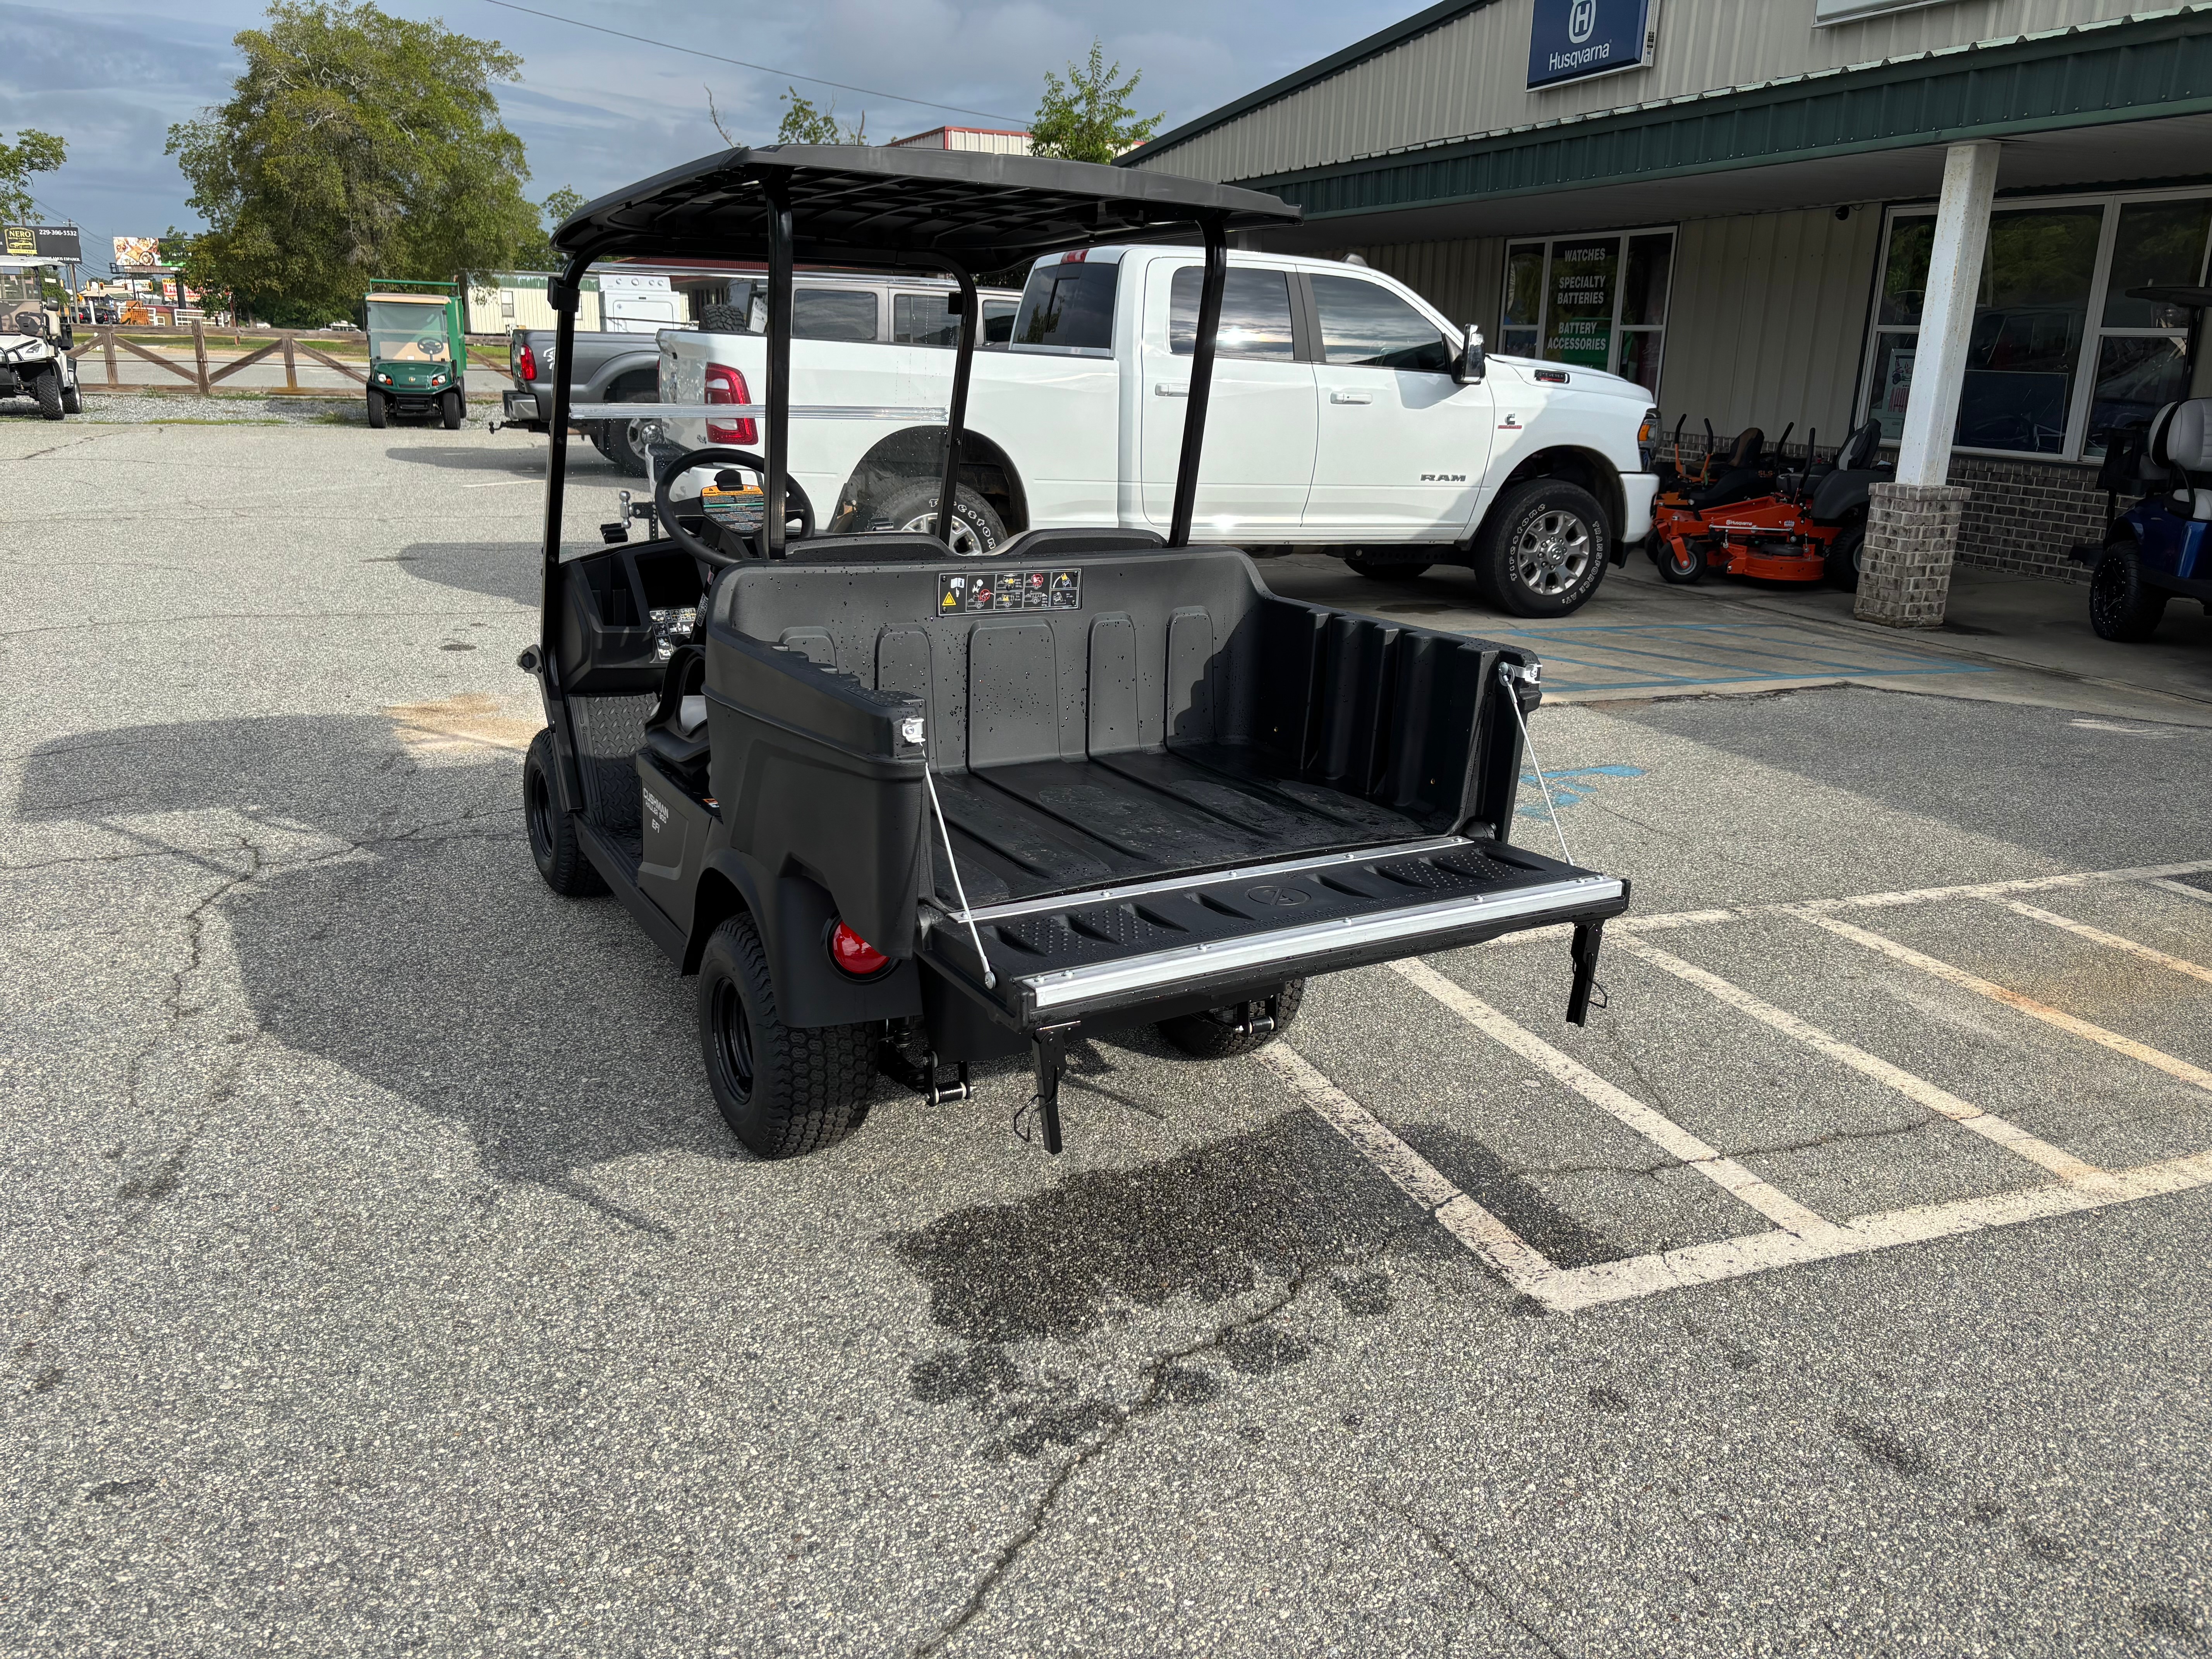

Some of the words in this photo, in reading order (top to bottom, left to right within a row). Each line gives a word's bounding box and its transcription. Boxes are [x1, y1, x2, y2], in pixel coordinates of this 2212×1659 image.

[1549, 43, 1609, 71] Husqvarna
[1565, 248, 1605, 262] WATCHES
[1559, 275, 1606, 289] SPECIALTY
[1558, 292, 1604, 304] BATTERIES
[1558, 322, 1597, 334] BATTERY
[1547, 337, 1606, 350] ACCESSORIES
[1579, 520, 1603, 594] TRANSFORCE
[643, 787, 669, 819] CUSHMAN
[652, 818, 660, 833] EFI
